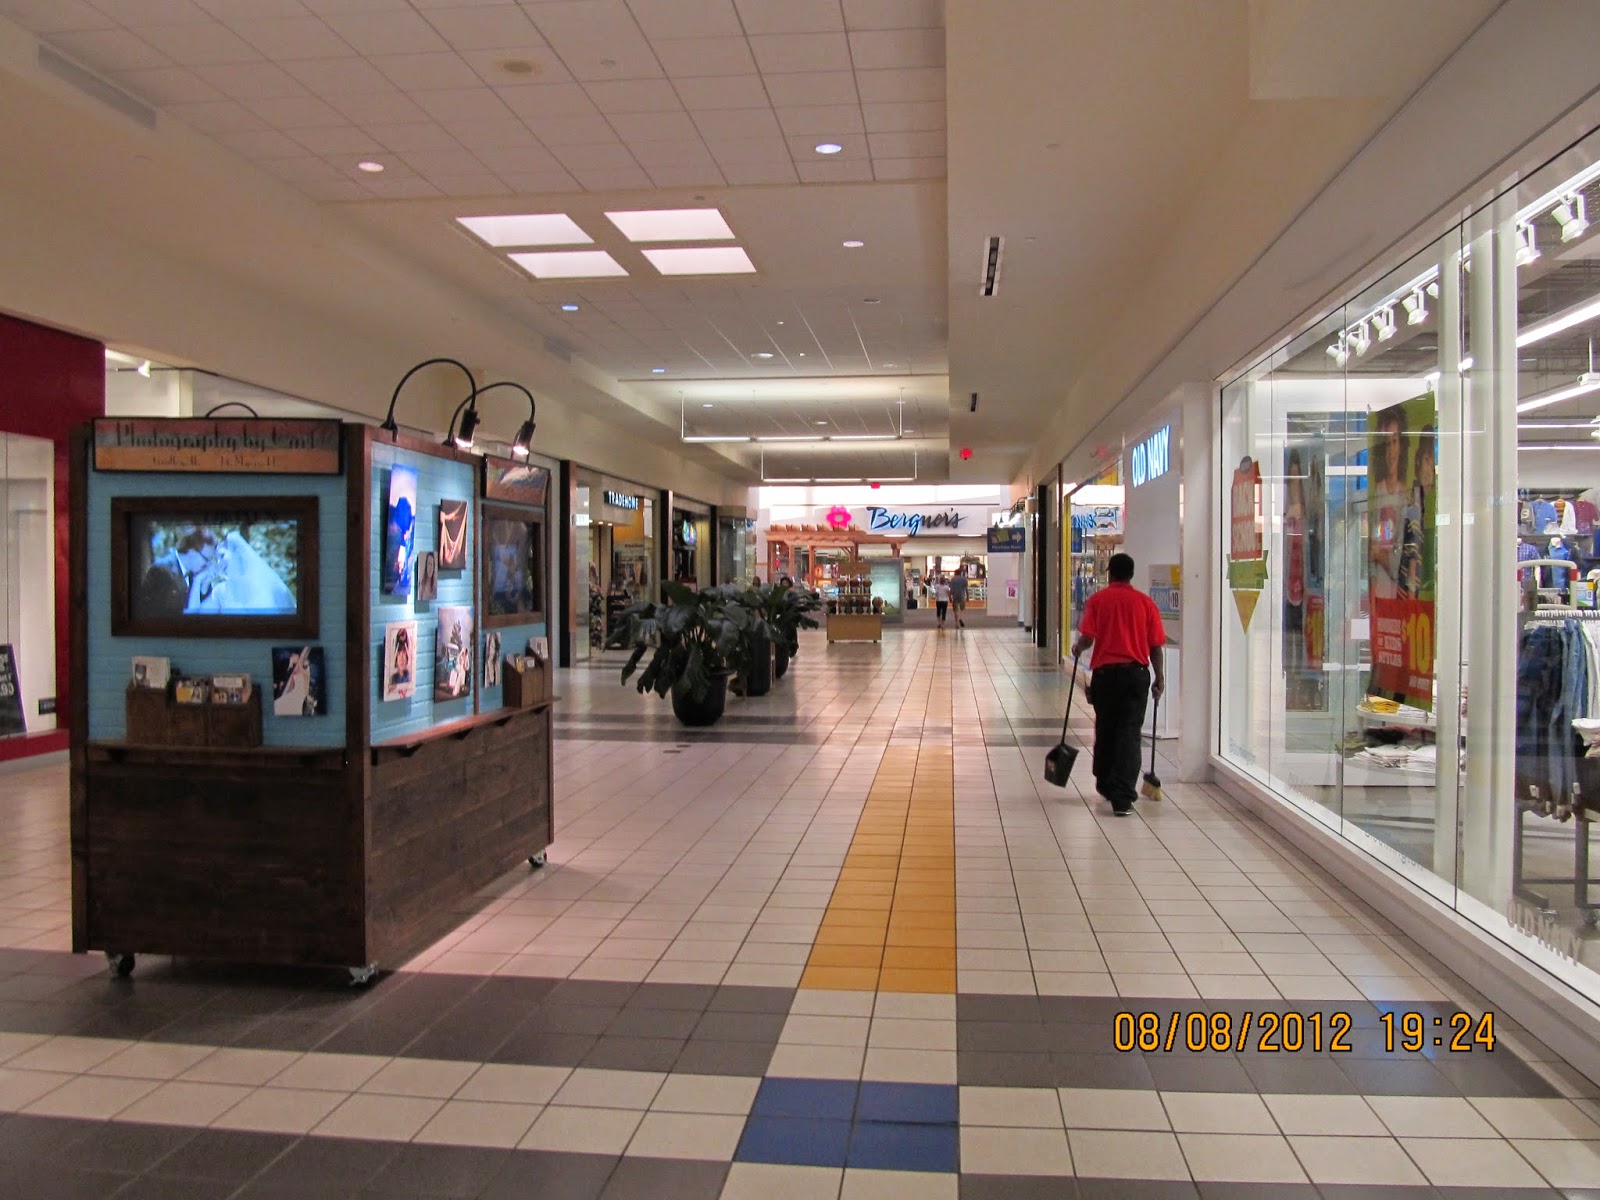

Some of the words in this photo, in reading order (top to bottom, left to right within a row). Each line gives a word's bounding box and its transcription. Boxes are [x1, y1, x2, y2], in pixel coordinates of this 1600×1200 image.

[1132, 443, 1146, 488] OLD
[1147, 425, 1170, 481] NAVY
[608, 490, 639, 511] TRADEHOME
[866, 505, 969, 537] Bergner's
